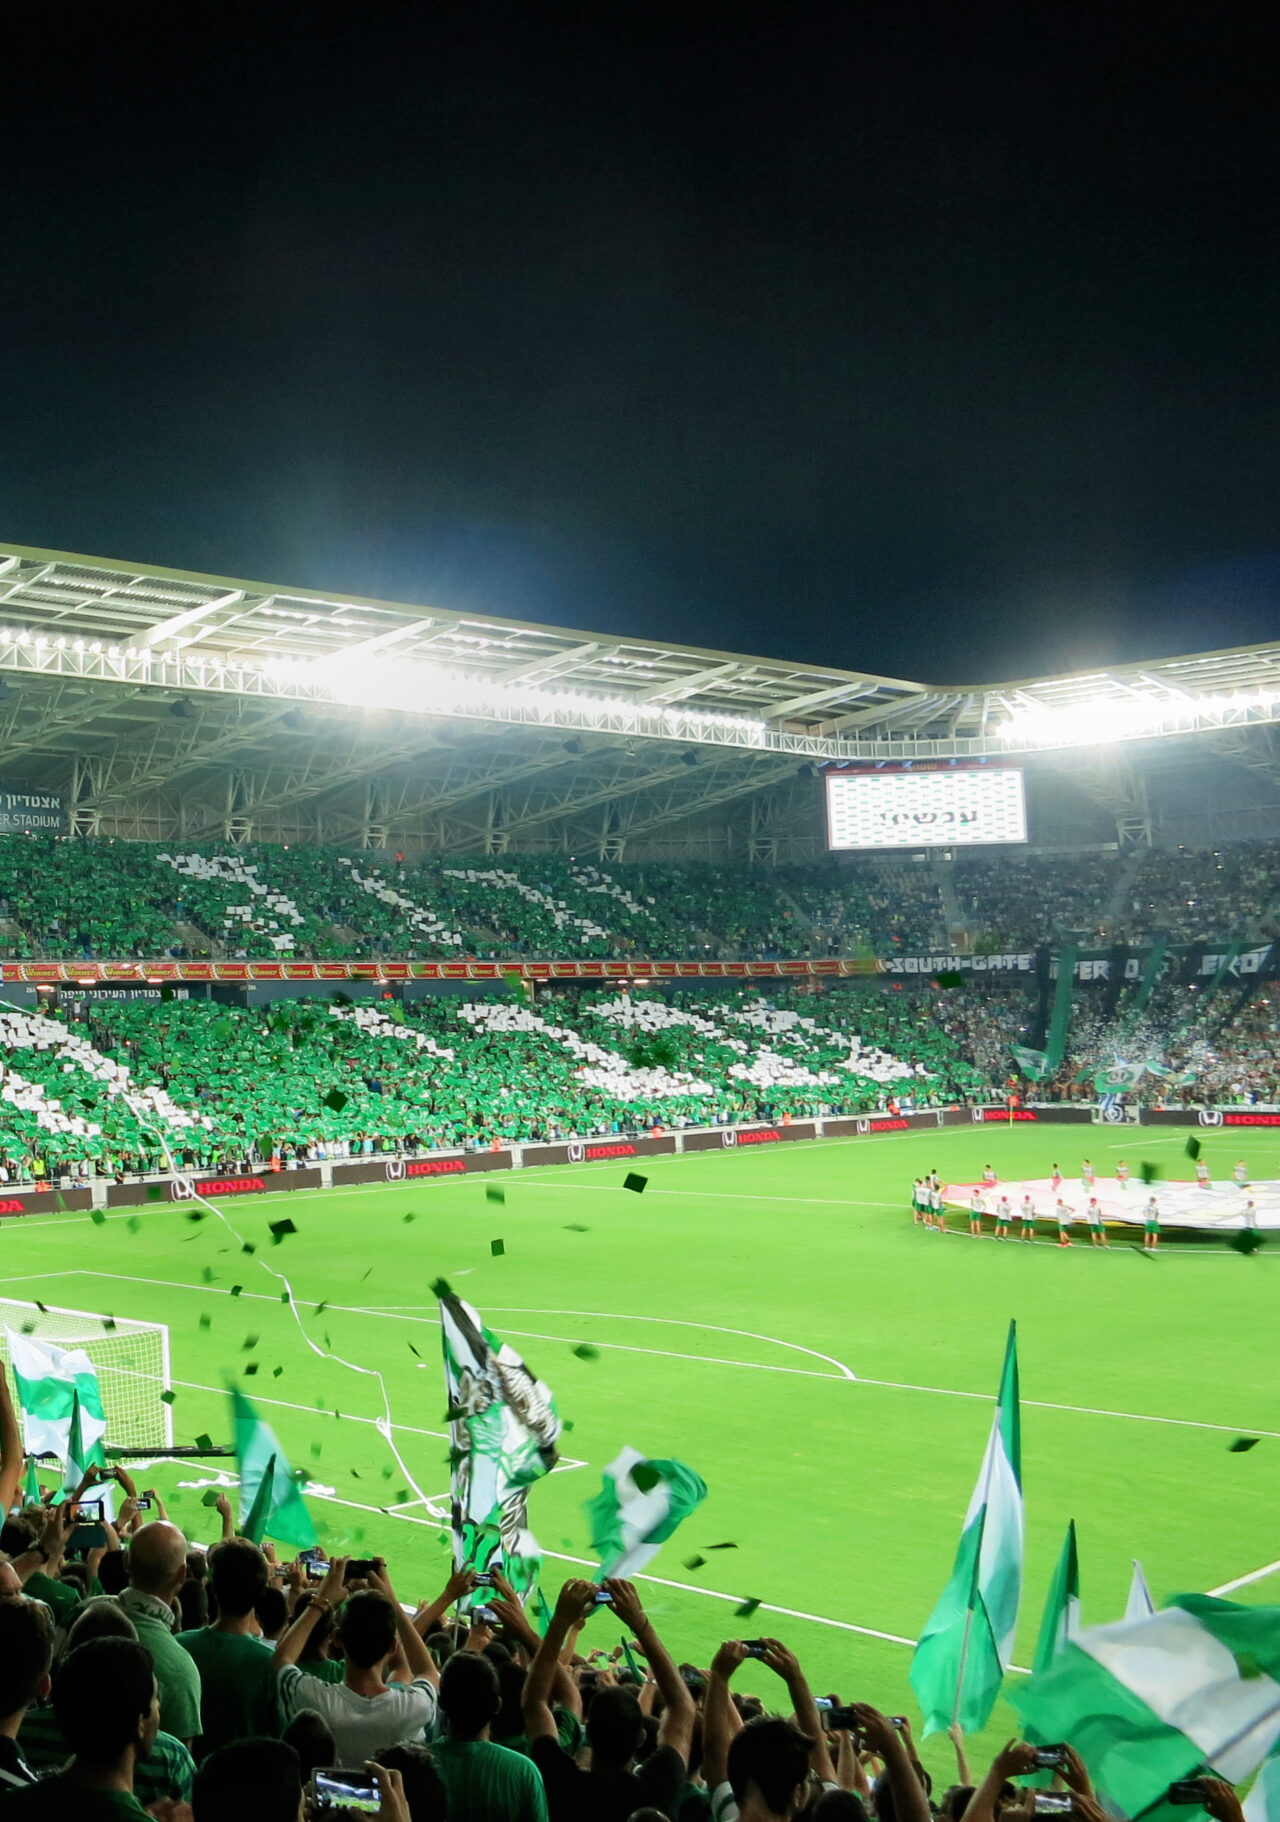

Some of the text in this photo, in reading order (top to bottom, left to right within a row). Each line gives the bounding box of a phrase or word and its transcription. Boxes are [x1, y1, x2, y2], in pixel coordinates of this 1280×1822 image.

[5, 793, 60, 809] אצטדיון
[13, 814, 60, 828] STADIUM
[60, 989, 177, 1000] הצטדיון העירוני חיפה
[586, 1144, 637, 1158] HONDA
[407, 1160, 466, 1175] HONDA
[196, 1177, 266, 1195] HONDA
